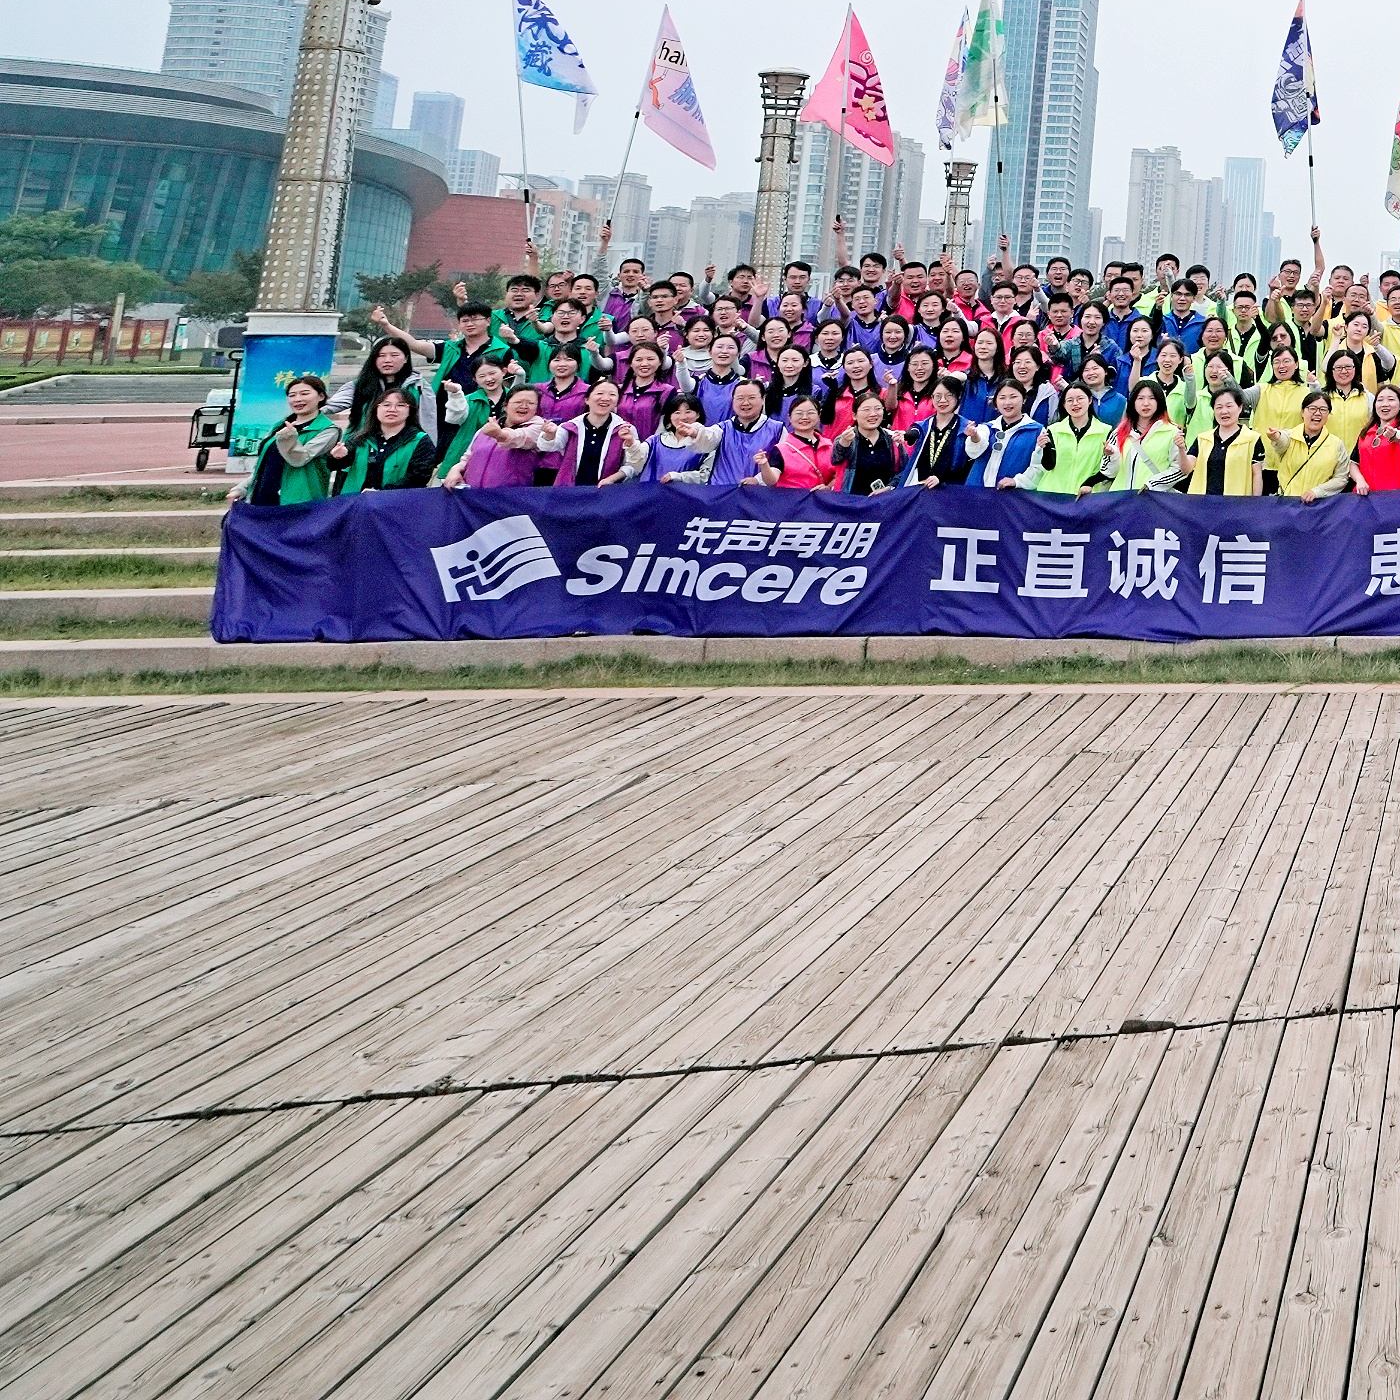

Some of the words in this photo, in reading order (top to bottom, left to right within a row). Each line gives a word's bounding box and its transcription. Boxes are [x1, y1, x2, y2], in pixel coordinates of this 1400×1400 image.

[678, 516, 882, 560] 先声再明
[929, 526, 1271, 605] 正直诚信
[565, 543, 868, 606] Simcere
